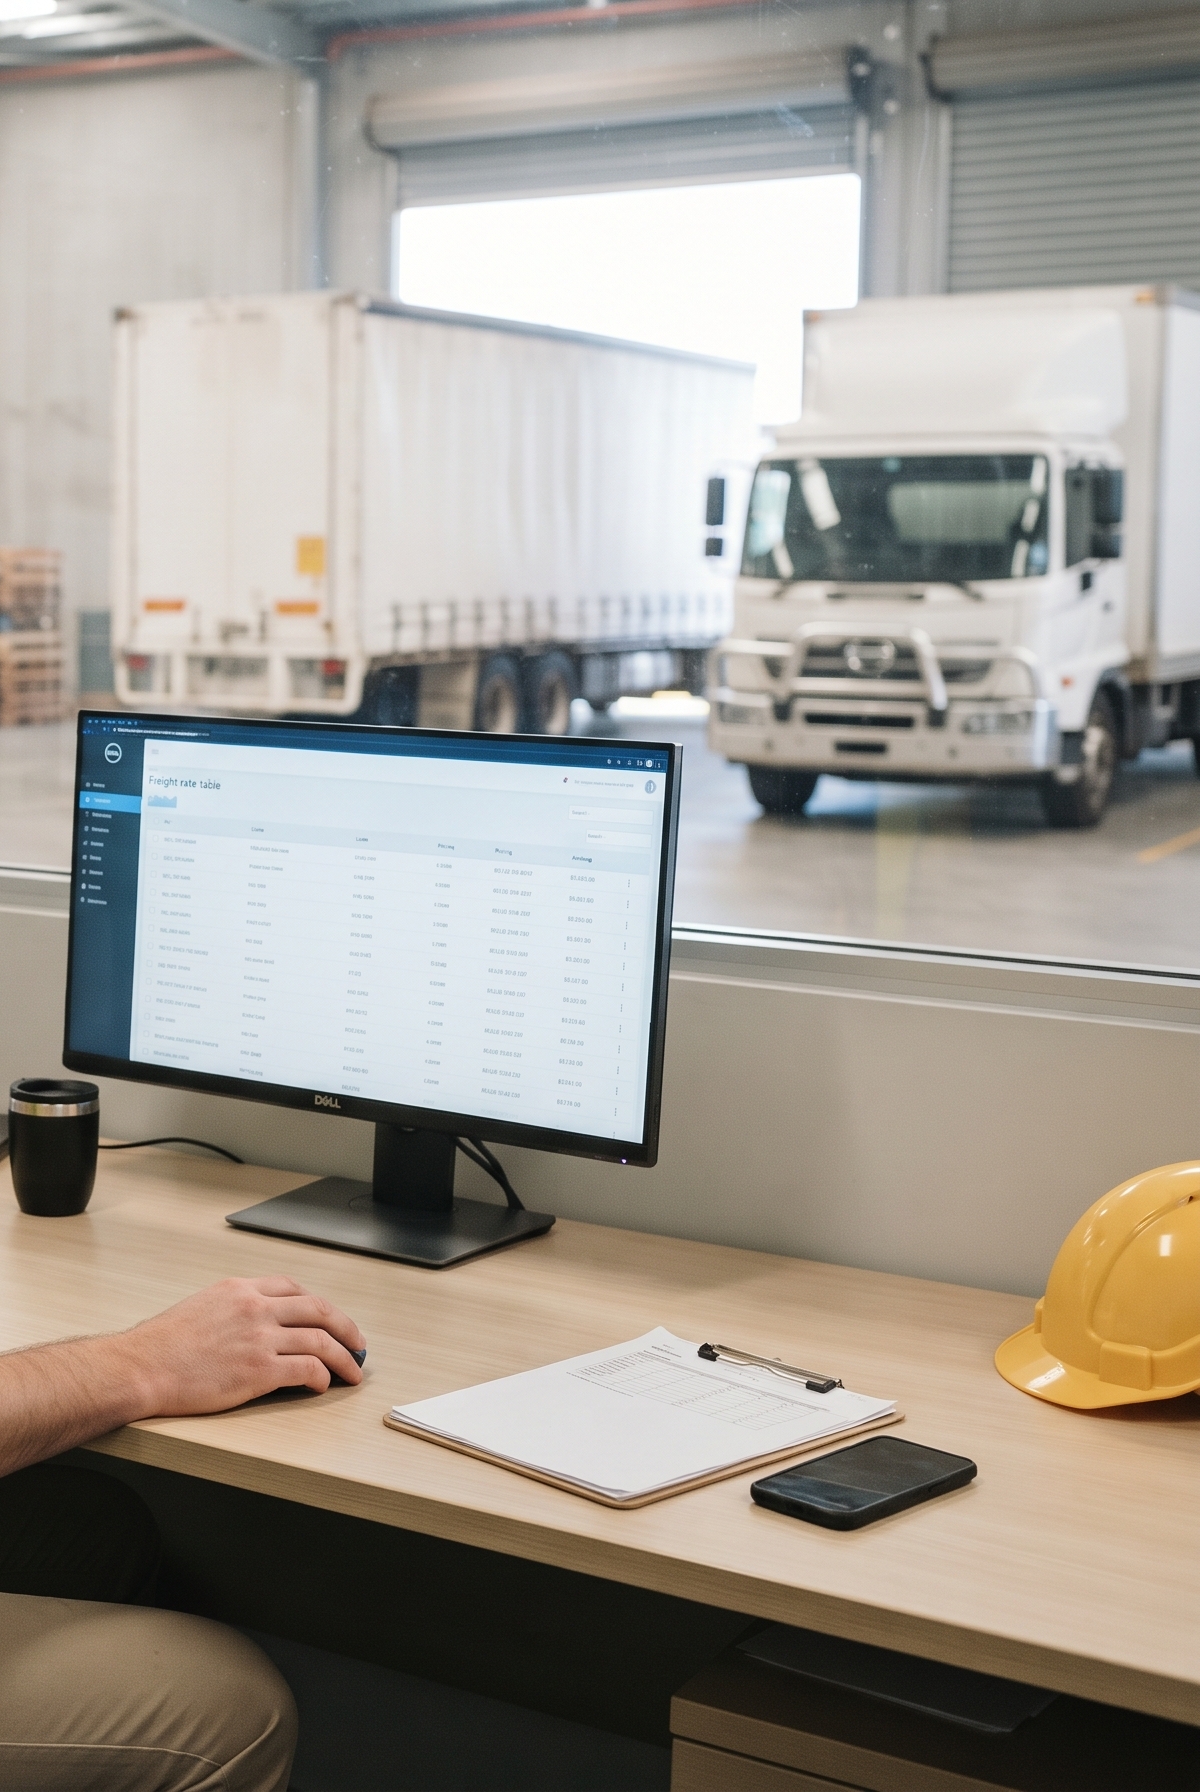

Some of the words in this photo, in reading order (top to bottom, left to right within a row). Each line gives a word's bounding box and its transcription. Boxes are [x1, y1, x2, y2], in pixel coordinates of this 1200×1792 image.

[149, 776, 178, 788] Freight
[180, 779, 197, 787] rate
[200, 778, 221, 789] table
[314, 1094, 341, 1108] DELL
